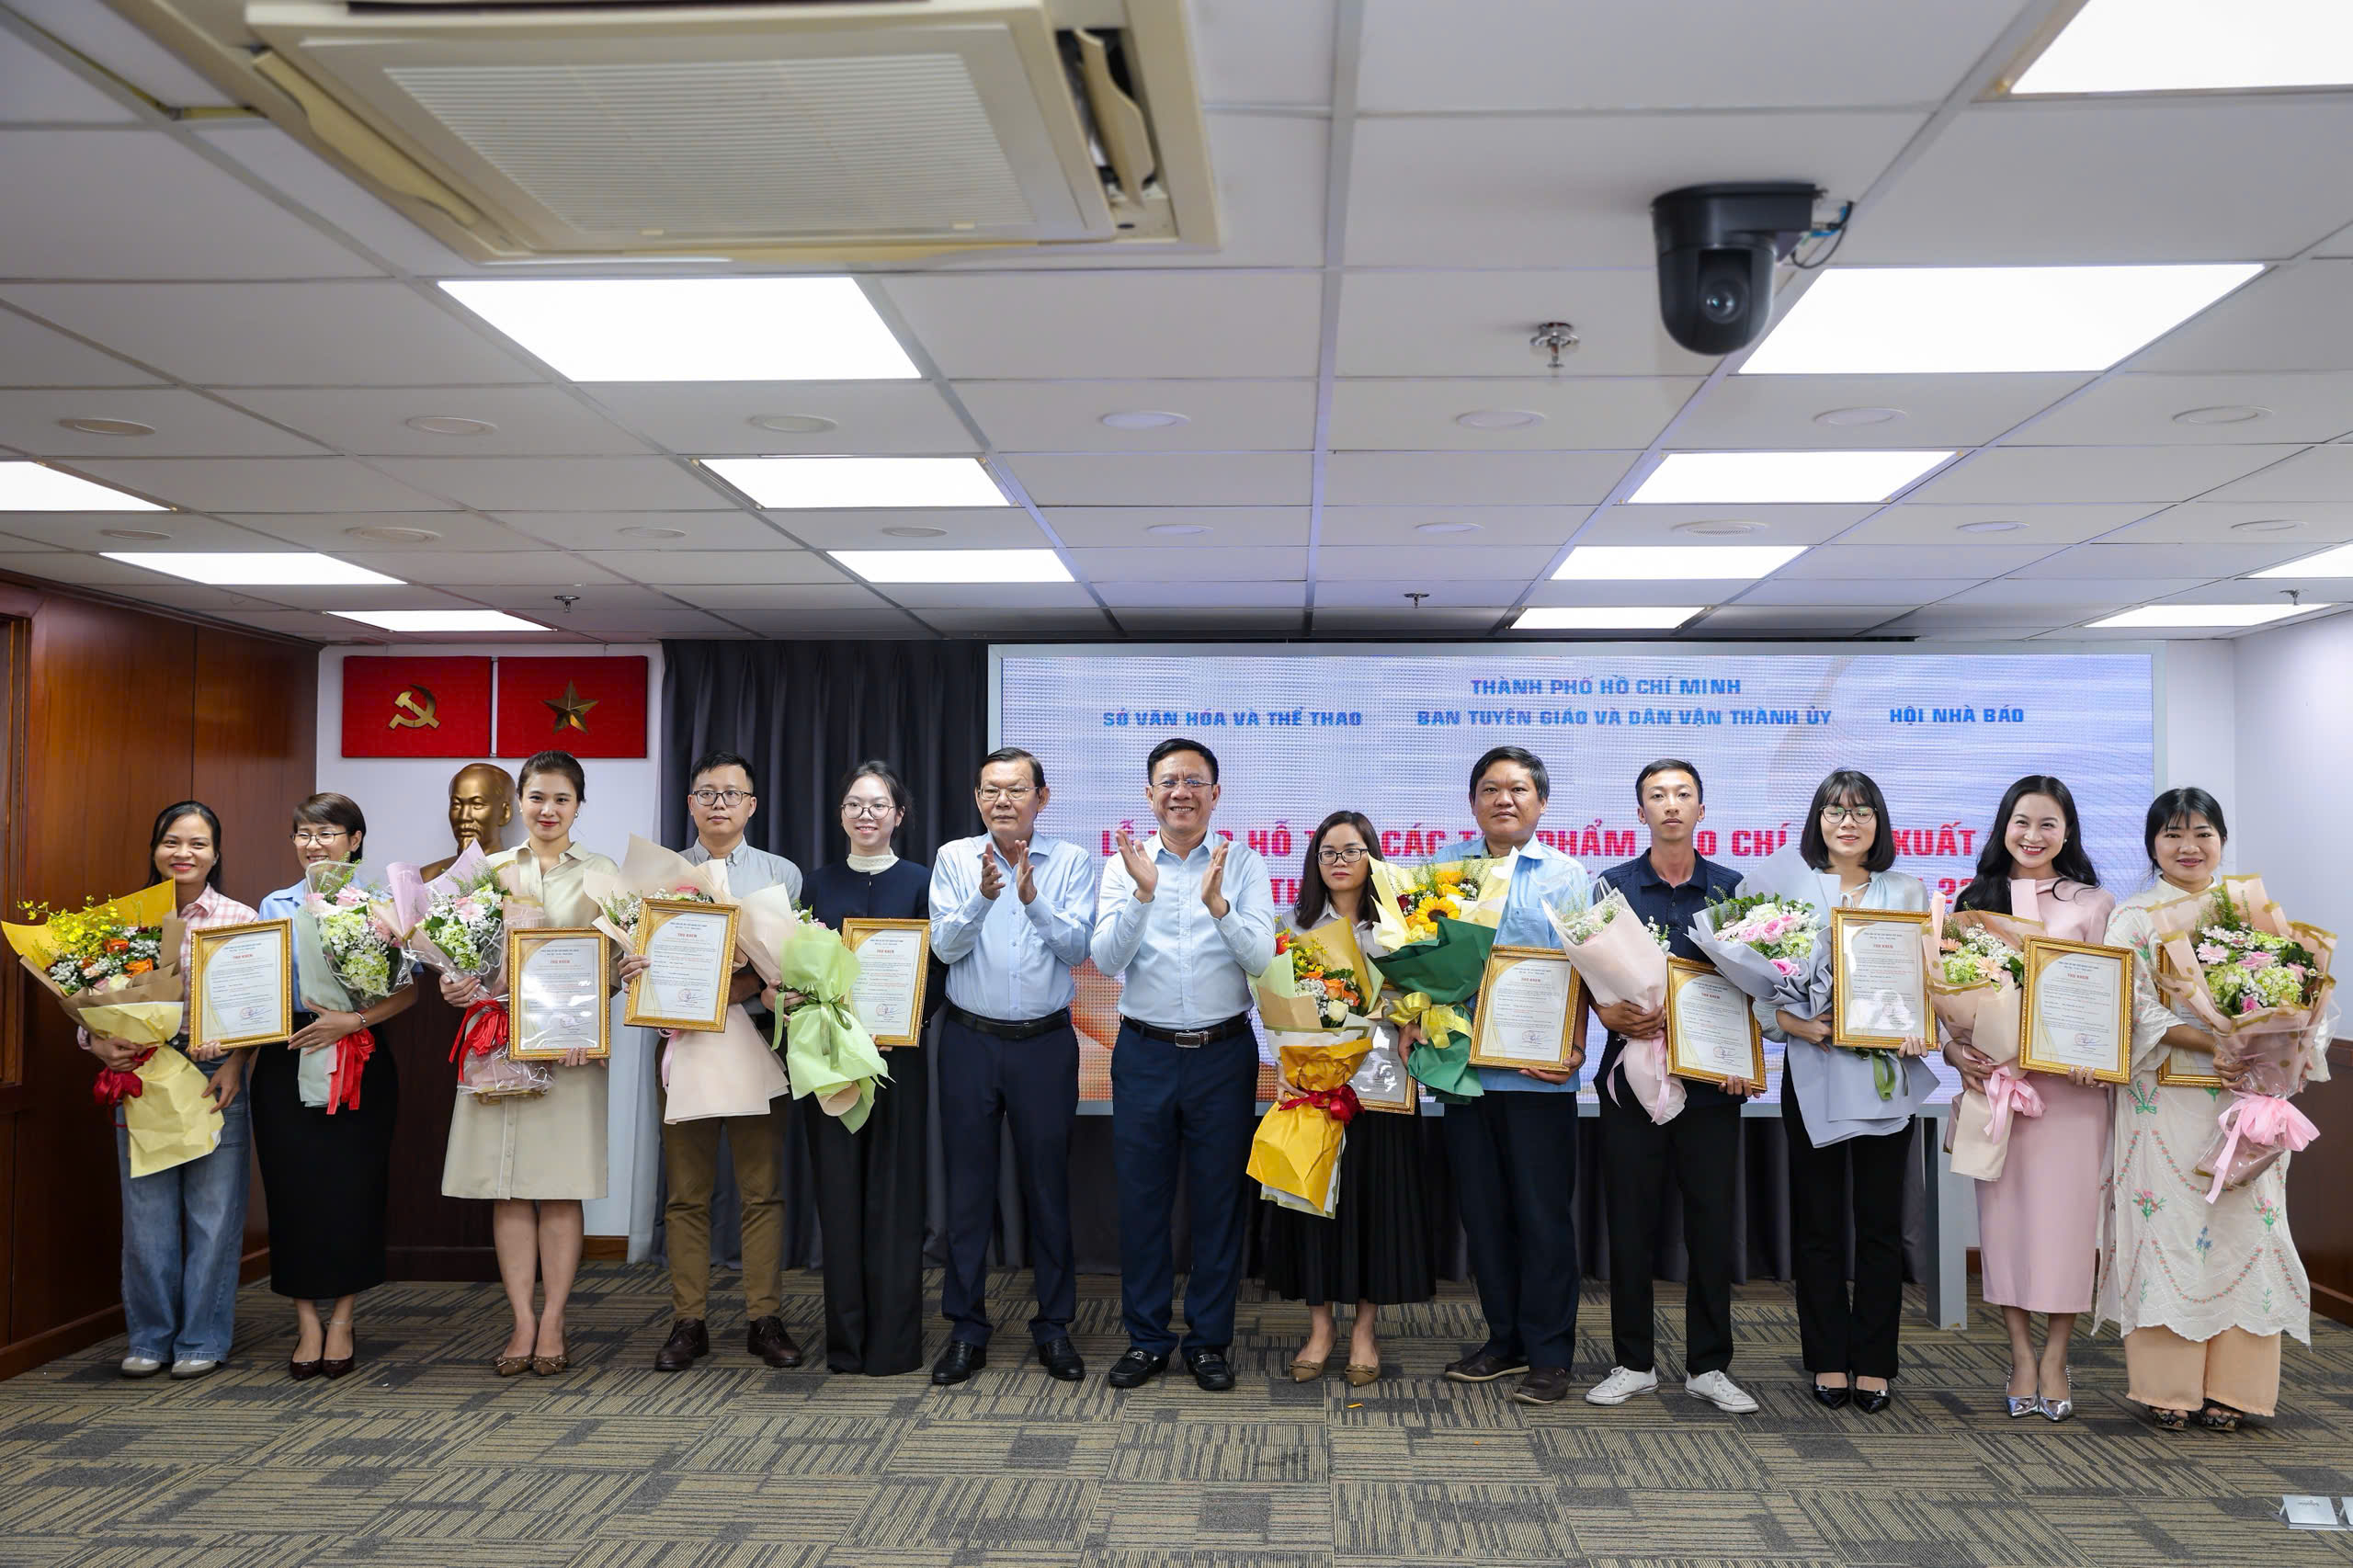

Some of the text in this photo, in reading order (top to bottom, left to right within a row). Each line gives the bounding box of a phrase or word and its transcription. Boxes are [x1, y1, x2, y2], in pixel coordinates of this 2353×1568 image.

[1471, 675, 1741, 694] THÀNH PHỐ HỒ CHÍ MINH
[1186, 707, 1227, 726] HÓA
[1233, 707, 1260, 726] VÀ
[1309, 711, 1362, 726] THAO
[1417, 706, 1832, 727] BAN TUYÊN GIÁO VÀ DÂN VẬN THÀNH ỦY
[1890, 705, 2024, 725] HỘI NHÀ BÁO
[1102, 819, 1134, 856] L
[1381, 823, 1446, 856] CÁC
[1732, 823, 1791, 856] CHÍ
[1892, 820, 1977, 856] XUẤT
